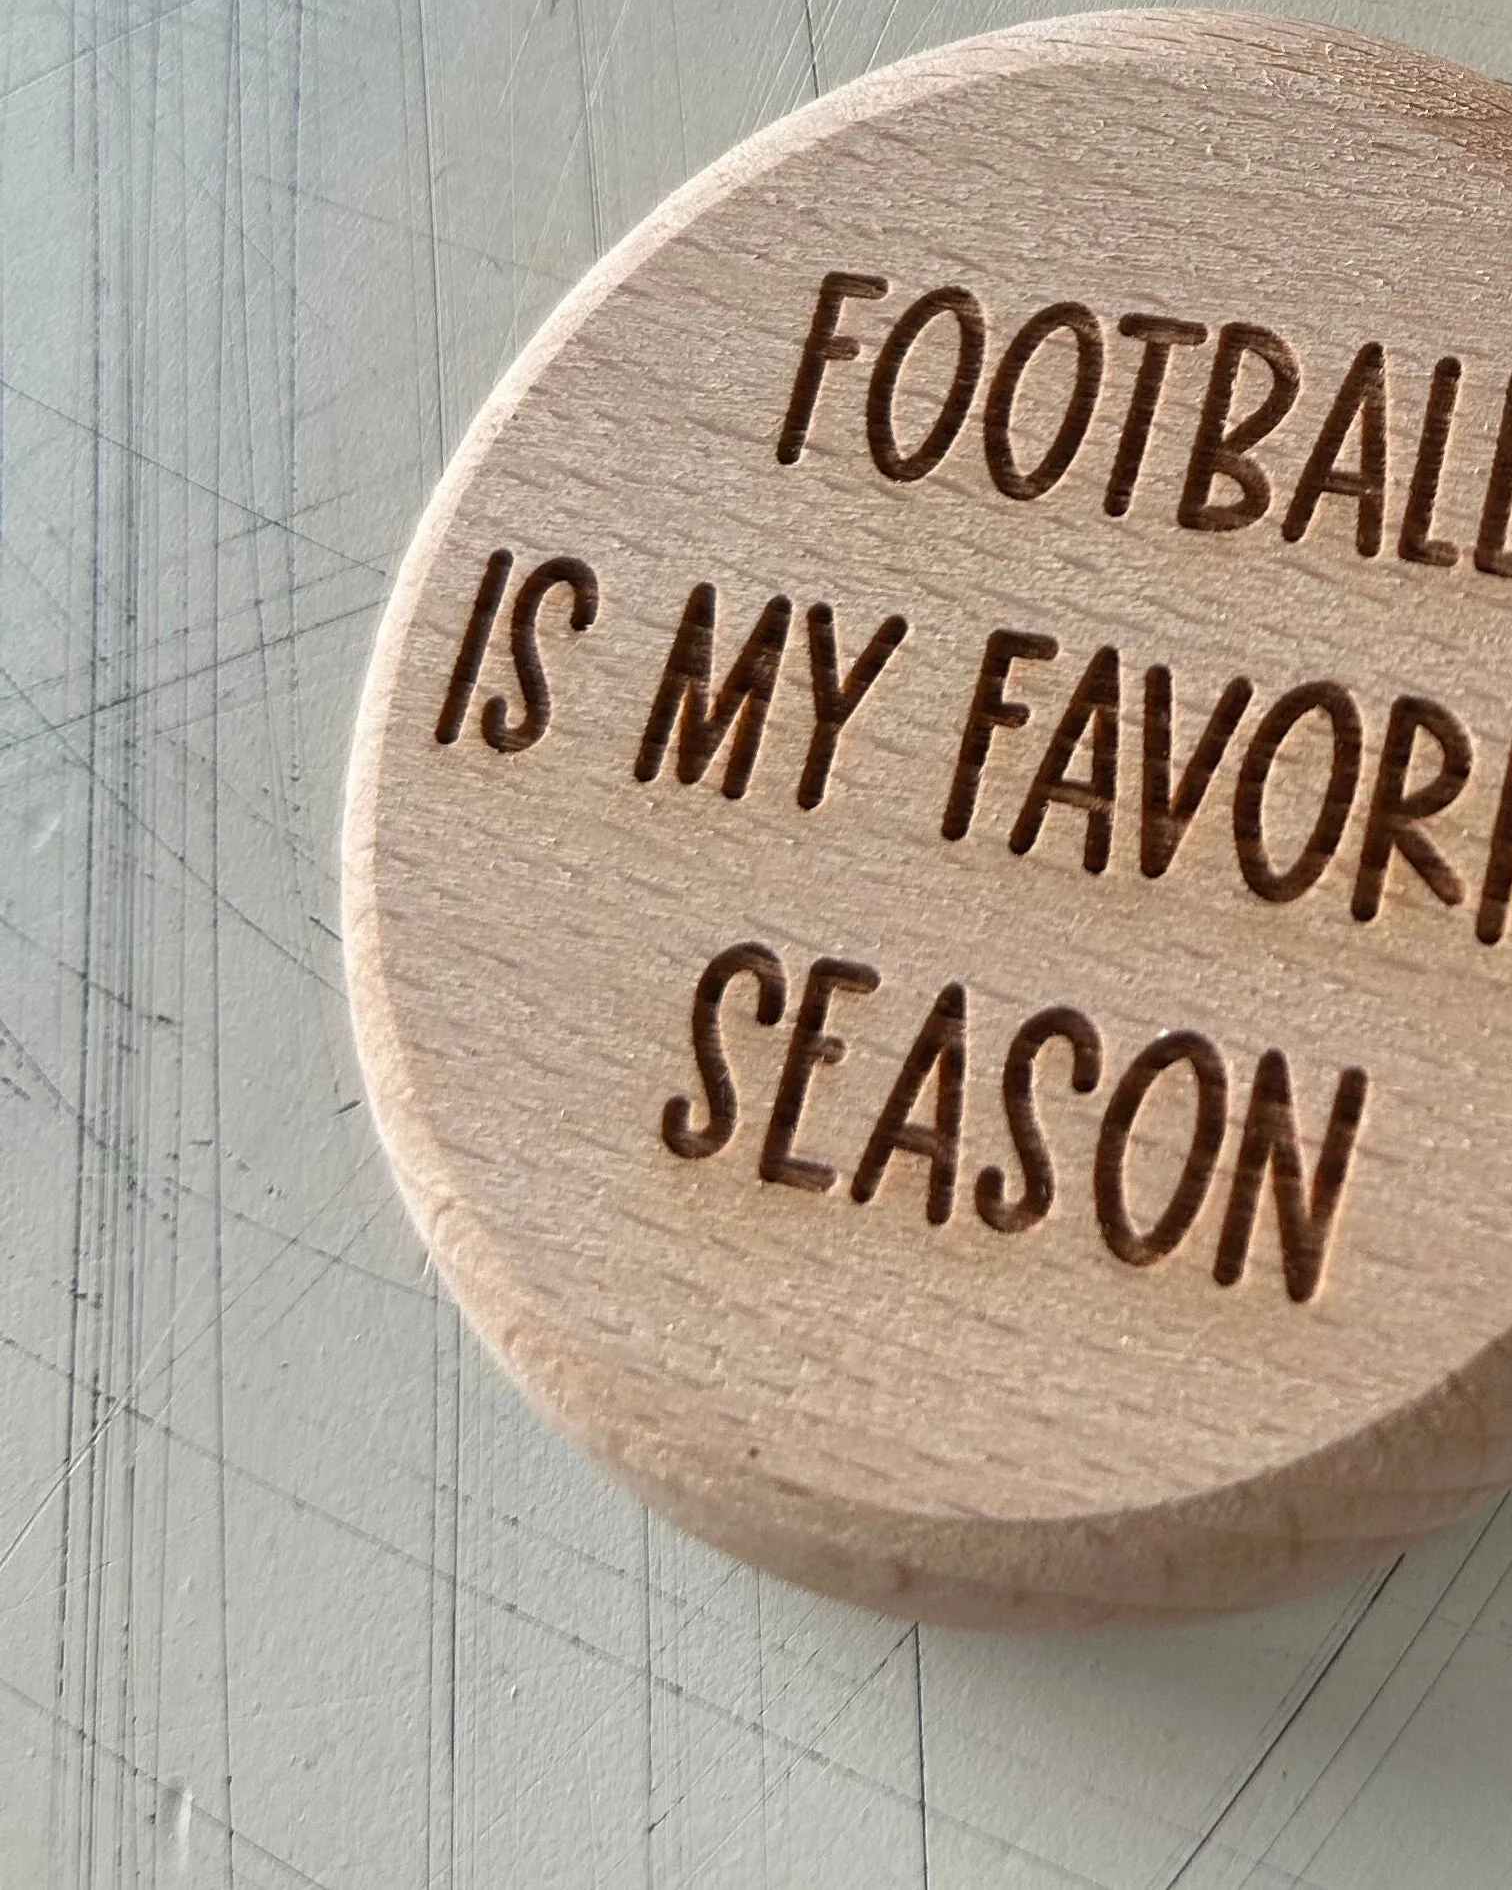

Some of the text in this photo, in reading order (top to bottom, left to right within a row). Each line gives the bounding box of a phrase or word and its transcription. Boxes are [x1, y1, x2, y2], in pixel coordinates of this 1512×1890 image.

[433, 548, 599, 755] IS
[632, 582, 908, 813] MY
[659, 942, 1368, 1305] SEASON
